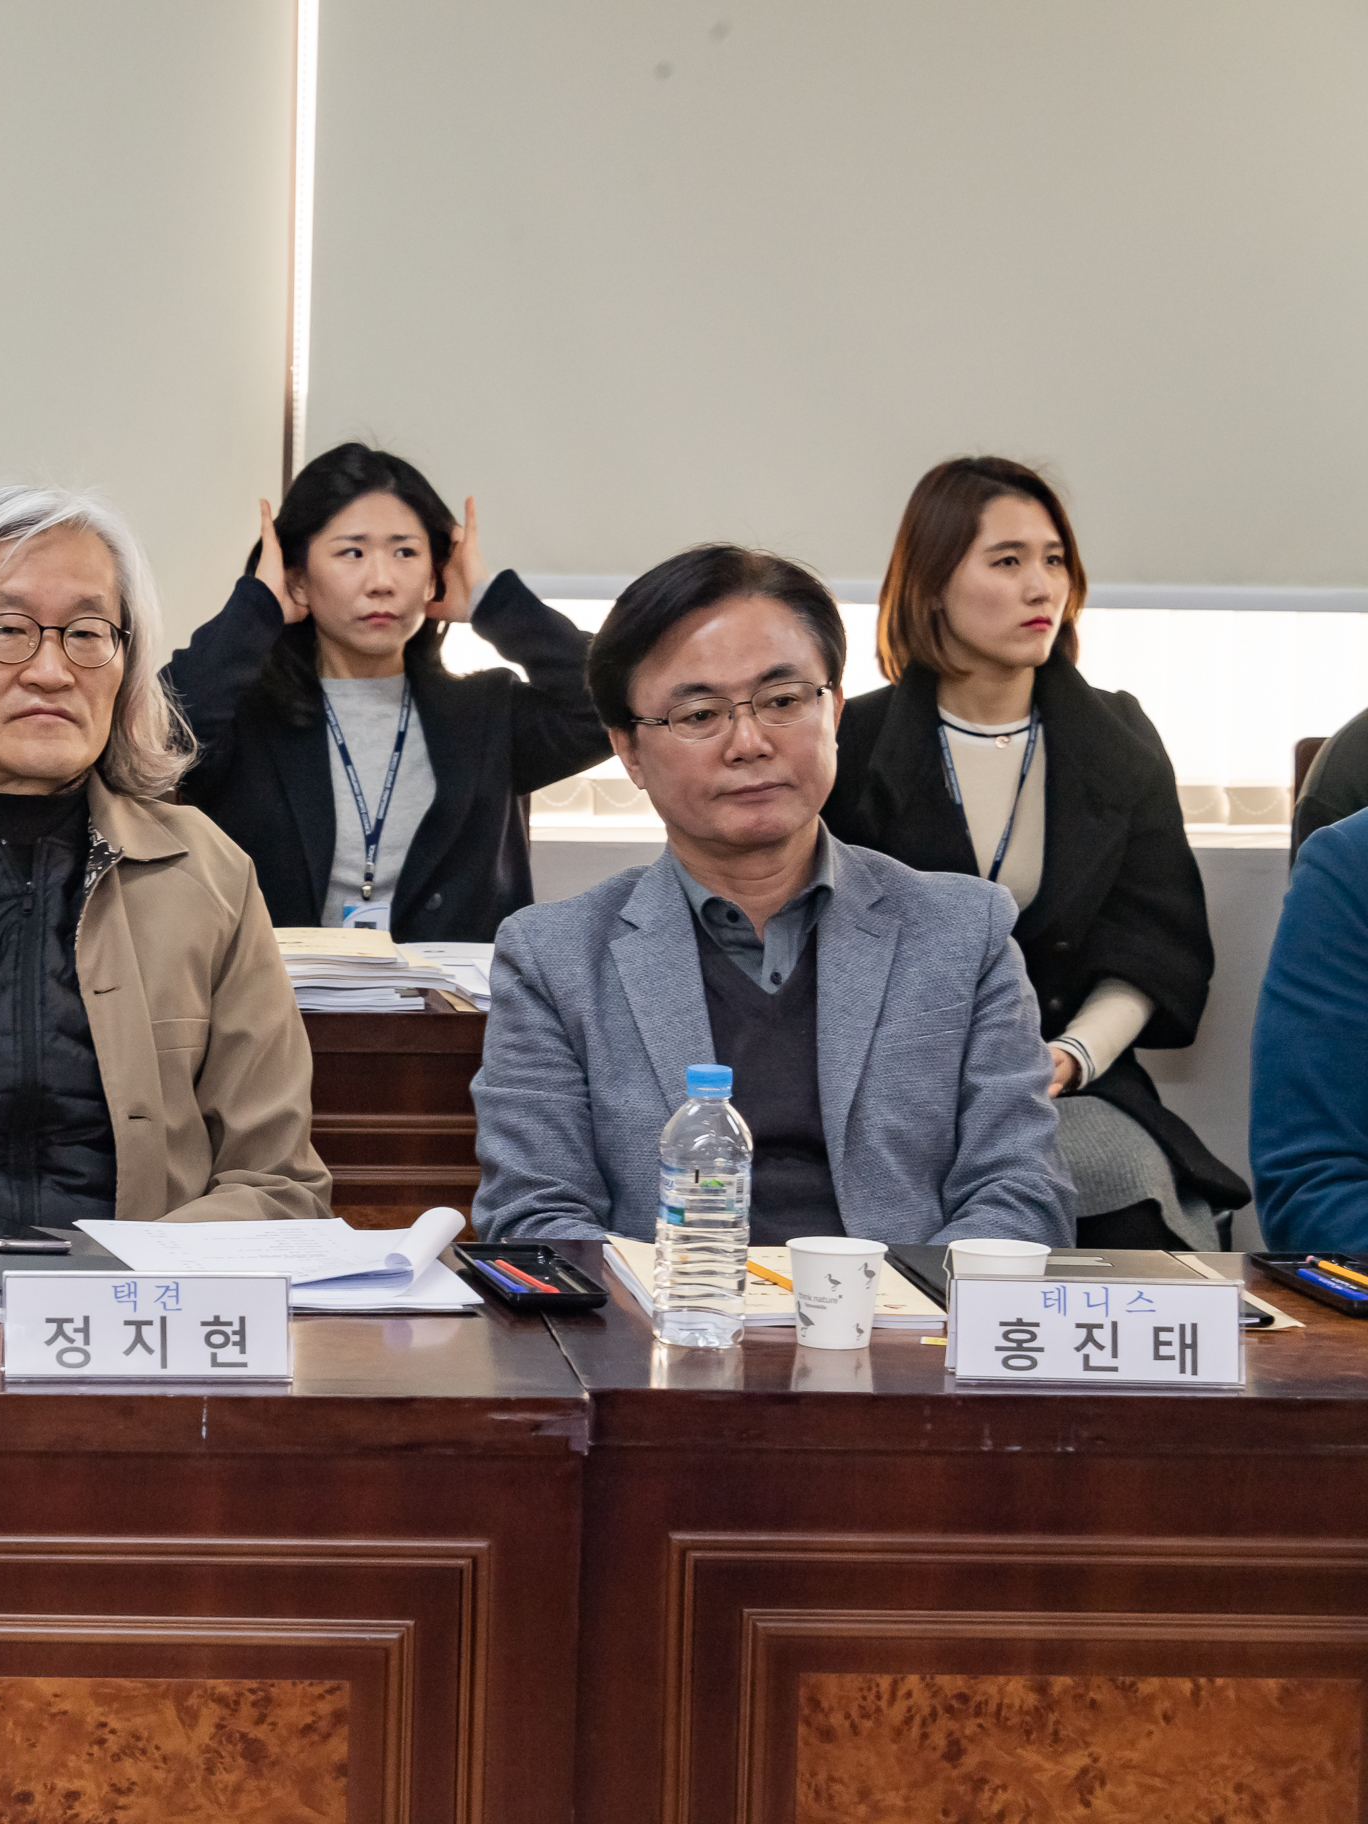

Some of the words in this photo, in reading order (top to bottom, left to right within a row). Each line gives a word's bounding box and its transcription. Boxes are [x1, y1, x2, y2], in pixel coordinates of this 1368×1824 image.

[111, 1281, 182, 1313] 택견
[813, 1296, 838, 1304] nature
[1041, 1285, 1157, 1317] 테니스
[44, 1315, 249, 1369] 정지현
[994, 1317, 1199, 1376] 홍진태
